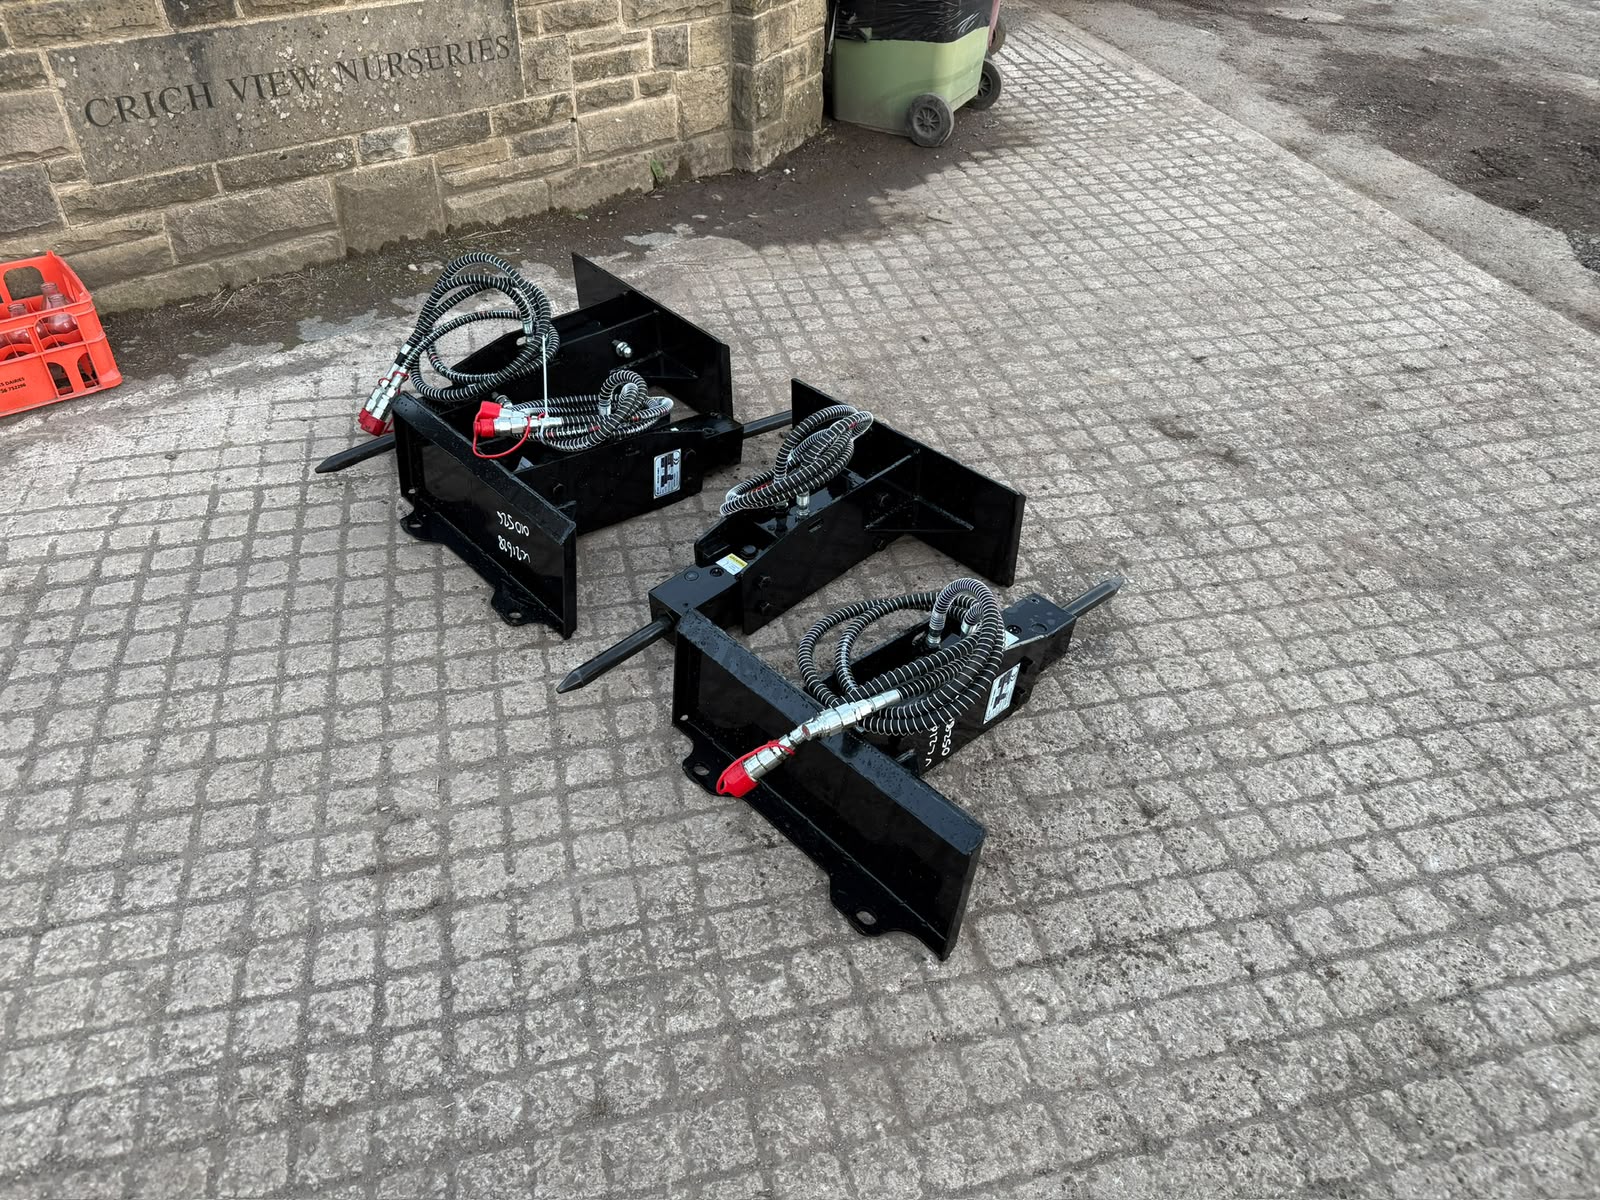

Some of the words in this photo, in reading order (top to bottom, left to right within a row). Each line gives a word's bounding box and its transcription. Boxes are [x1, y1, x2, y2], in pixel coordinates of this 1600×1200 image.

[84, 82, 216, 128] CRICH
[225, 65, 321, 101] VIEW
[333, 34, 512, 85] NURSERIES
